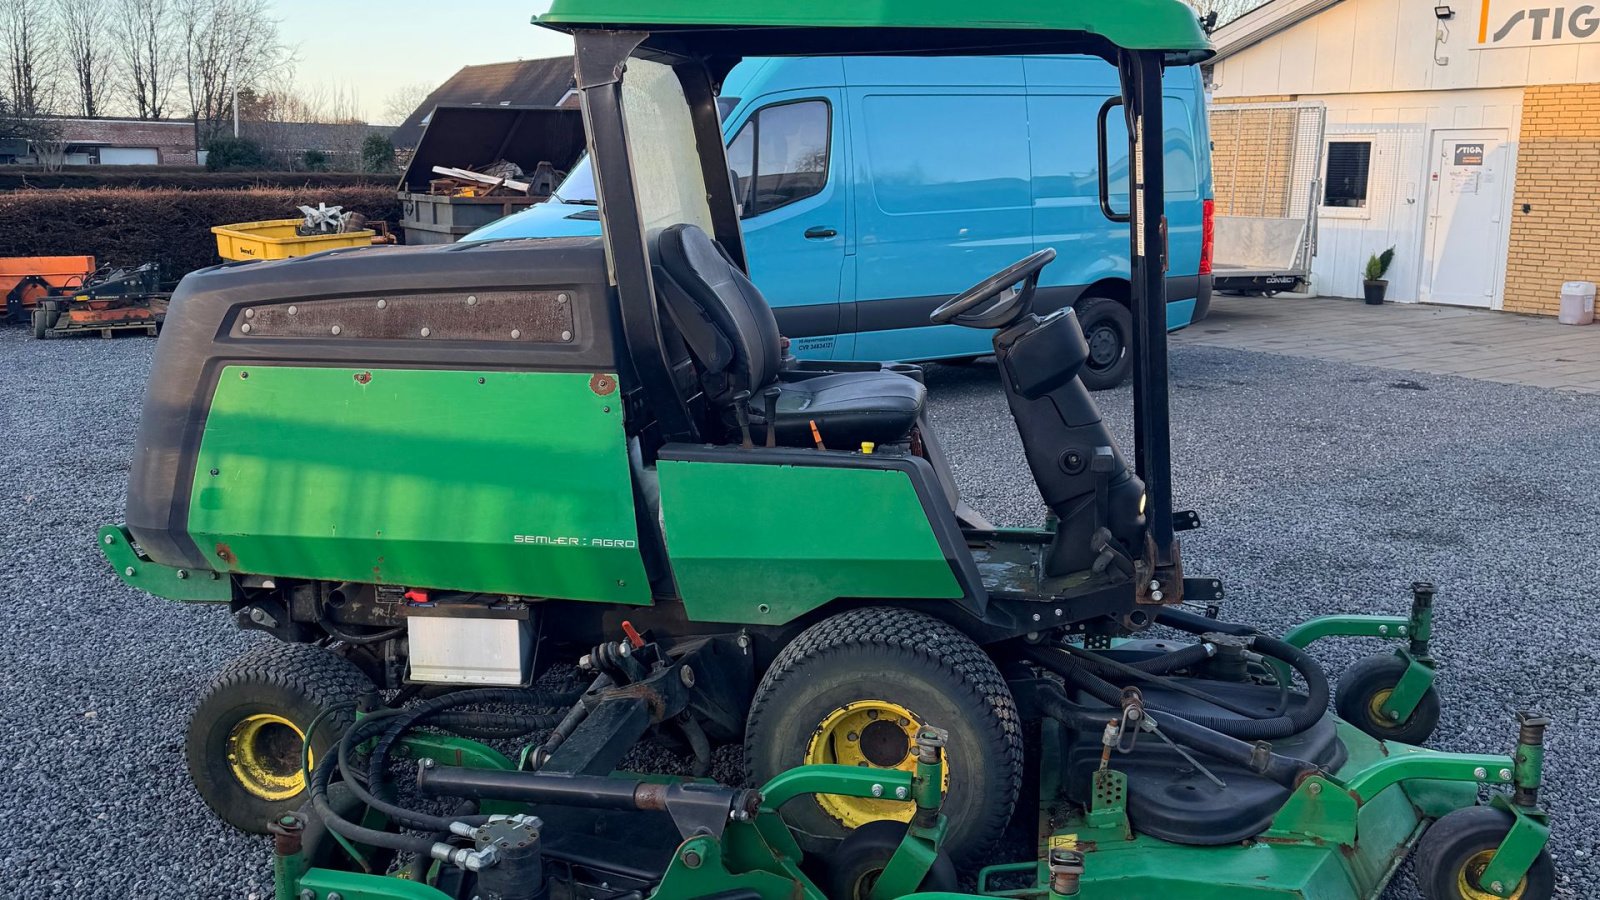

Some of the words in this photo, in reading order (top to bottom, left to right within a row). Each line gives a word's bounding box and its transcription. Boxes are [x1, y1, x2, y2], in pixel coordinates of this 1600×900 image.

[1456, 146, 1483, 154] STIGA
[514, 534, 579, 546] SEMLER
[592, 538, 636, 548] AGRO
